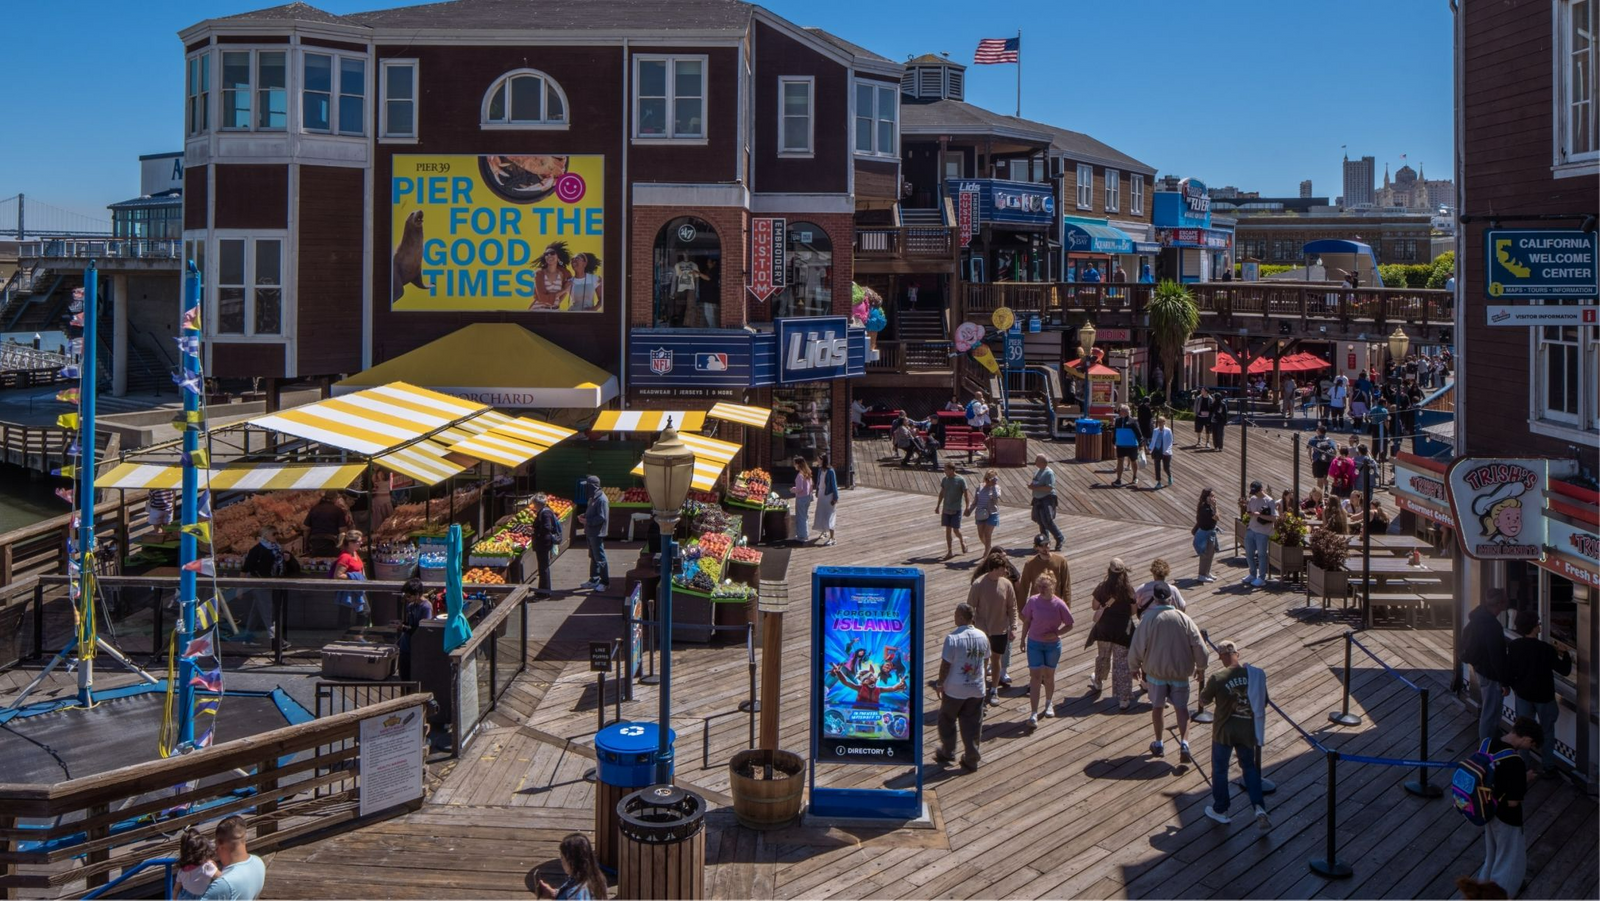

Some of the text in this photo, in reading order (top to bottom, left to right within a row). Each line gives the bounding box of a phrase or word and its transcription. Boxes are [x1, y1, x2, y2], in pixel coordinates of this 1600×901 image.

[171, 158, 184, 181] A
[392, 176, 474, 204] PIER
[959, 182, 981, 192] Lids
[1191, 198, 1210, 212] FLYER
[449, 207, 603, 235] FOR THE
[1519, 238, 1591, 249] CALIFORNIA
[422, 238, 531, 267] GOOD
[756, 221, 768, 294] CUSTOM
[774, 222, 783, 283] EMBROIDERY
[1529, 253, 1592, 263] WELCOME
[1542, 268, 1592, 278] CENTER
[422, 269, 535, 297] TIMES
[1008, 338, 1022, 346] PIER
[786, 331, 847, 370] Lids
[1007, 345, 1023, 361] 39
[652, 359, 670, 371] NFL
[1464, 464, 1539, 491] TRISH'S
[1407, 500, 1434, 517] Gourmet
[1564, 562, 1591, 582] Fresh
[837, 610, 901, 618] FORGOTTEN
[832, 617, 904, 632] ISLAND
[847, 747, 885, 755] DIRECTORY
